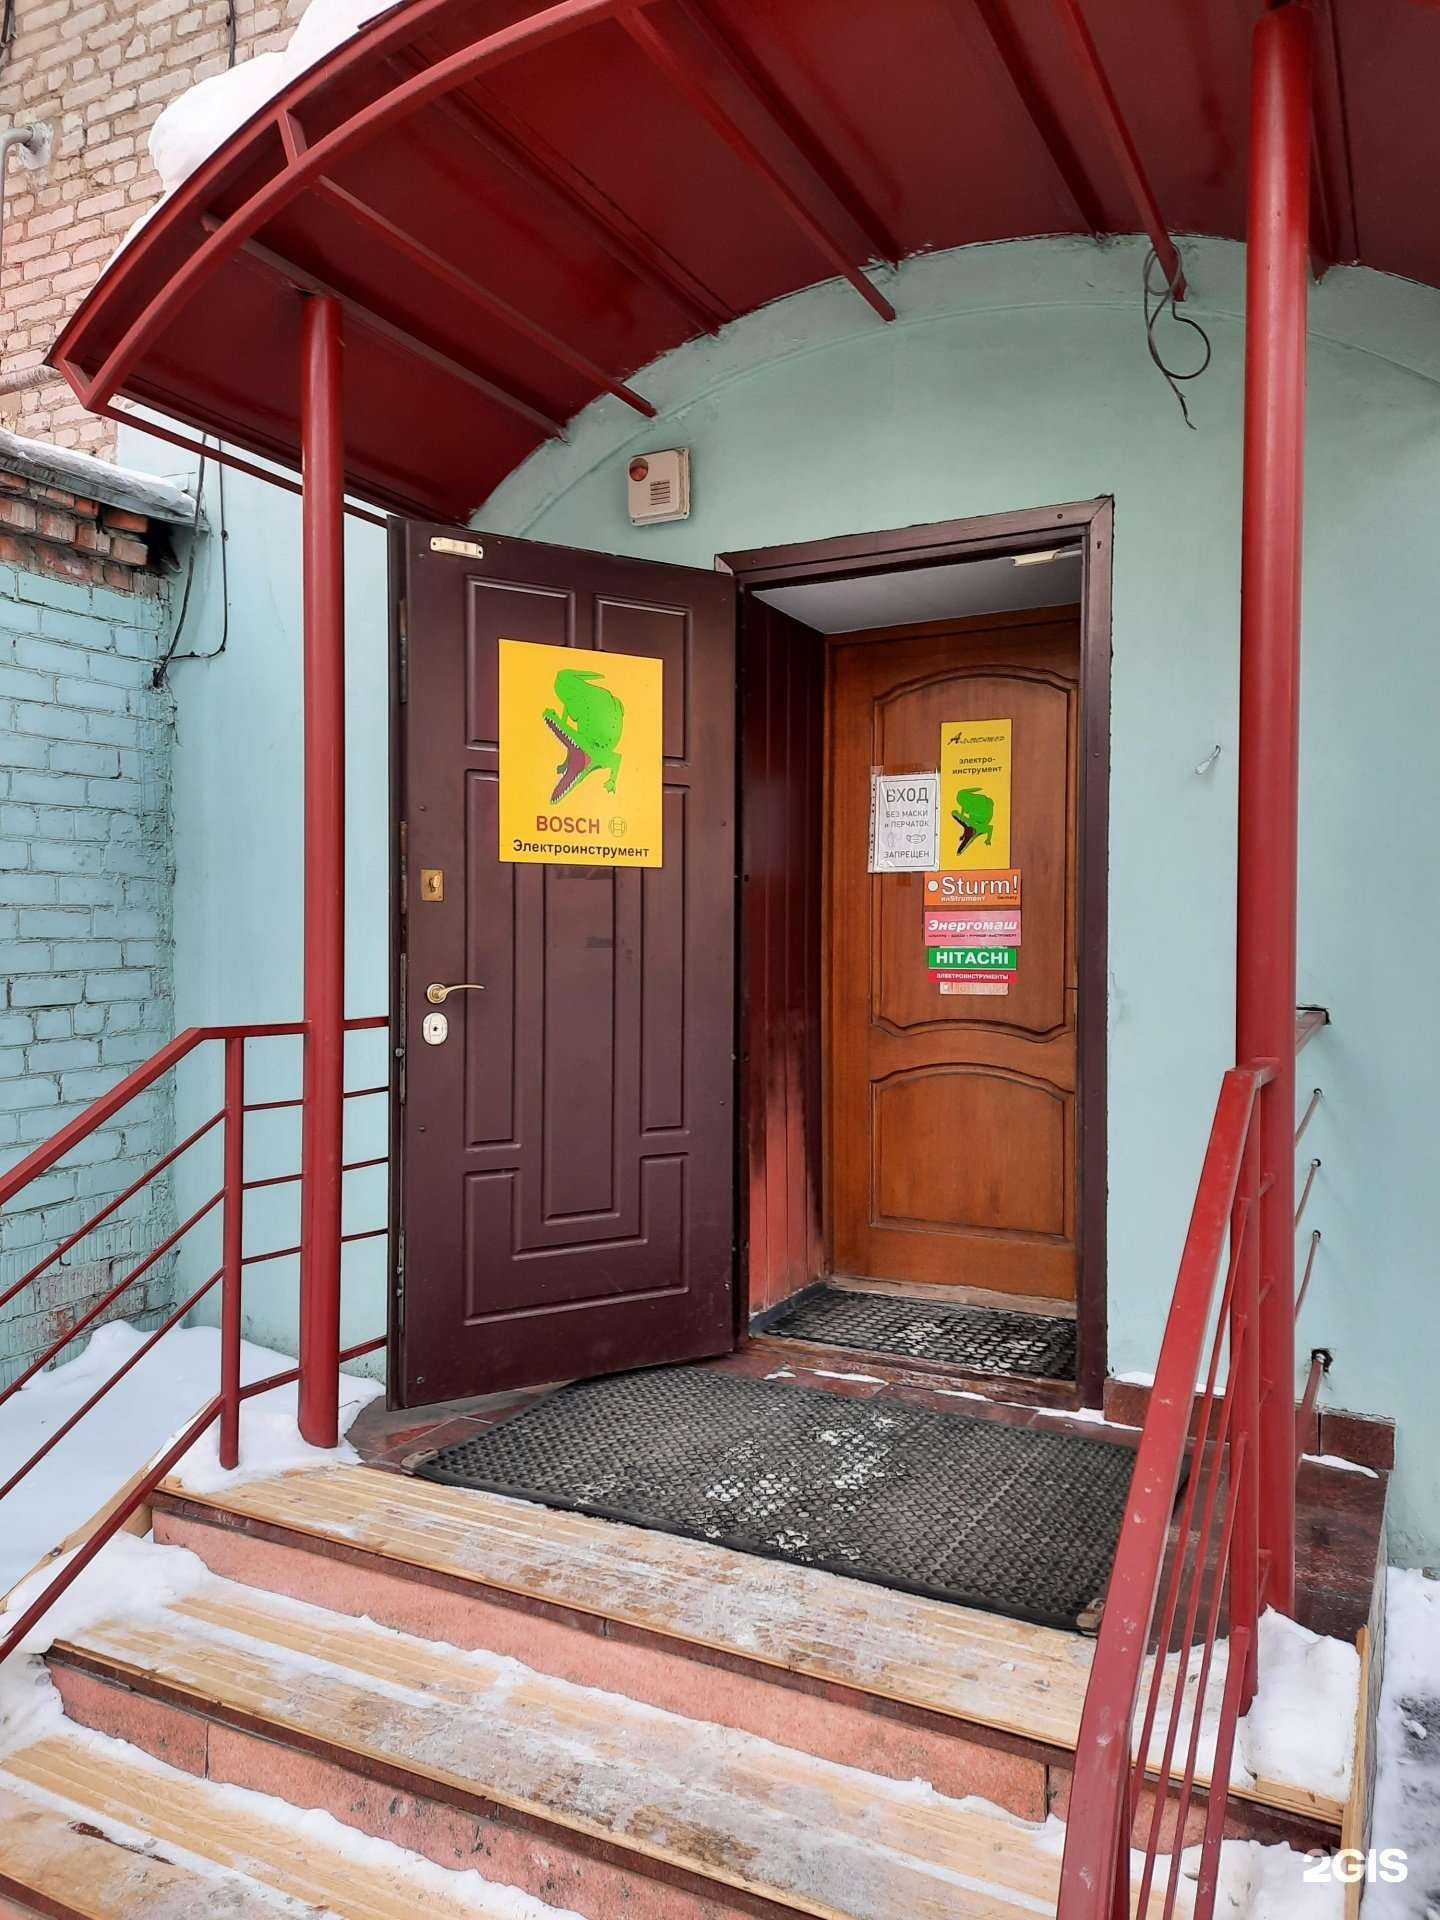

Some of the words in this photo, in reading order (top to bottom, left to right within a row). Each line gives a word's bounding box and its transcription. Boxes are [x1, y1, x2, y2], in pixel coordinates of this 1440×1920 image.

[952, 766, 1002, 776] инструмент
[886, 787, 929, 804] ВХОД
[886, 810, 900, 818] БЕЗ
[902, 810, 928, 818] МАСКИ
[536, 815, 600, 834] BOSCH
[891, 820, 929, 828] ПЕРЧАТОК
[513, 839, 650, 858] Электроинструмент
[883, 850, 930, 859] ЗАПРЕЩЕН
[942, 875, 1019, 895] Sturm!
[928, 919, 1018, 932] Энергомаш
[936, 951, 1009, 965] HITACHI
